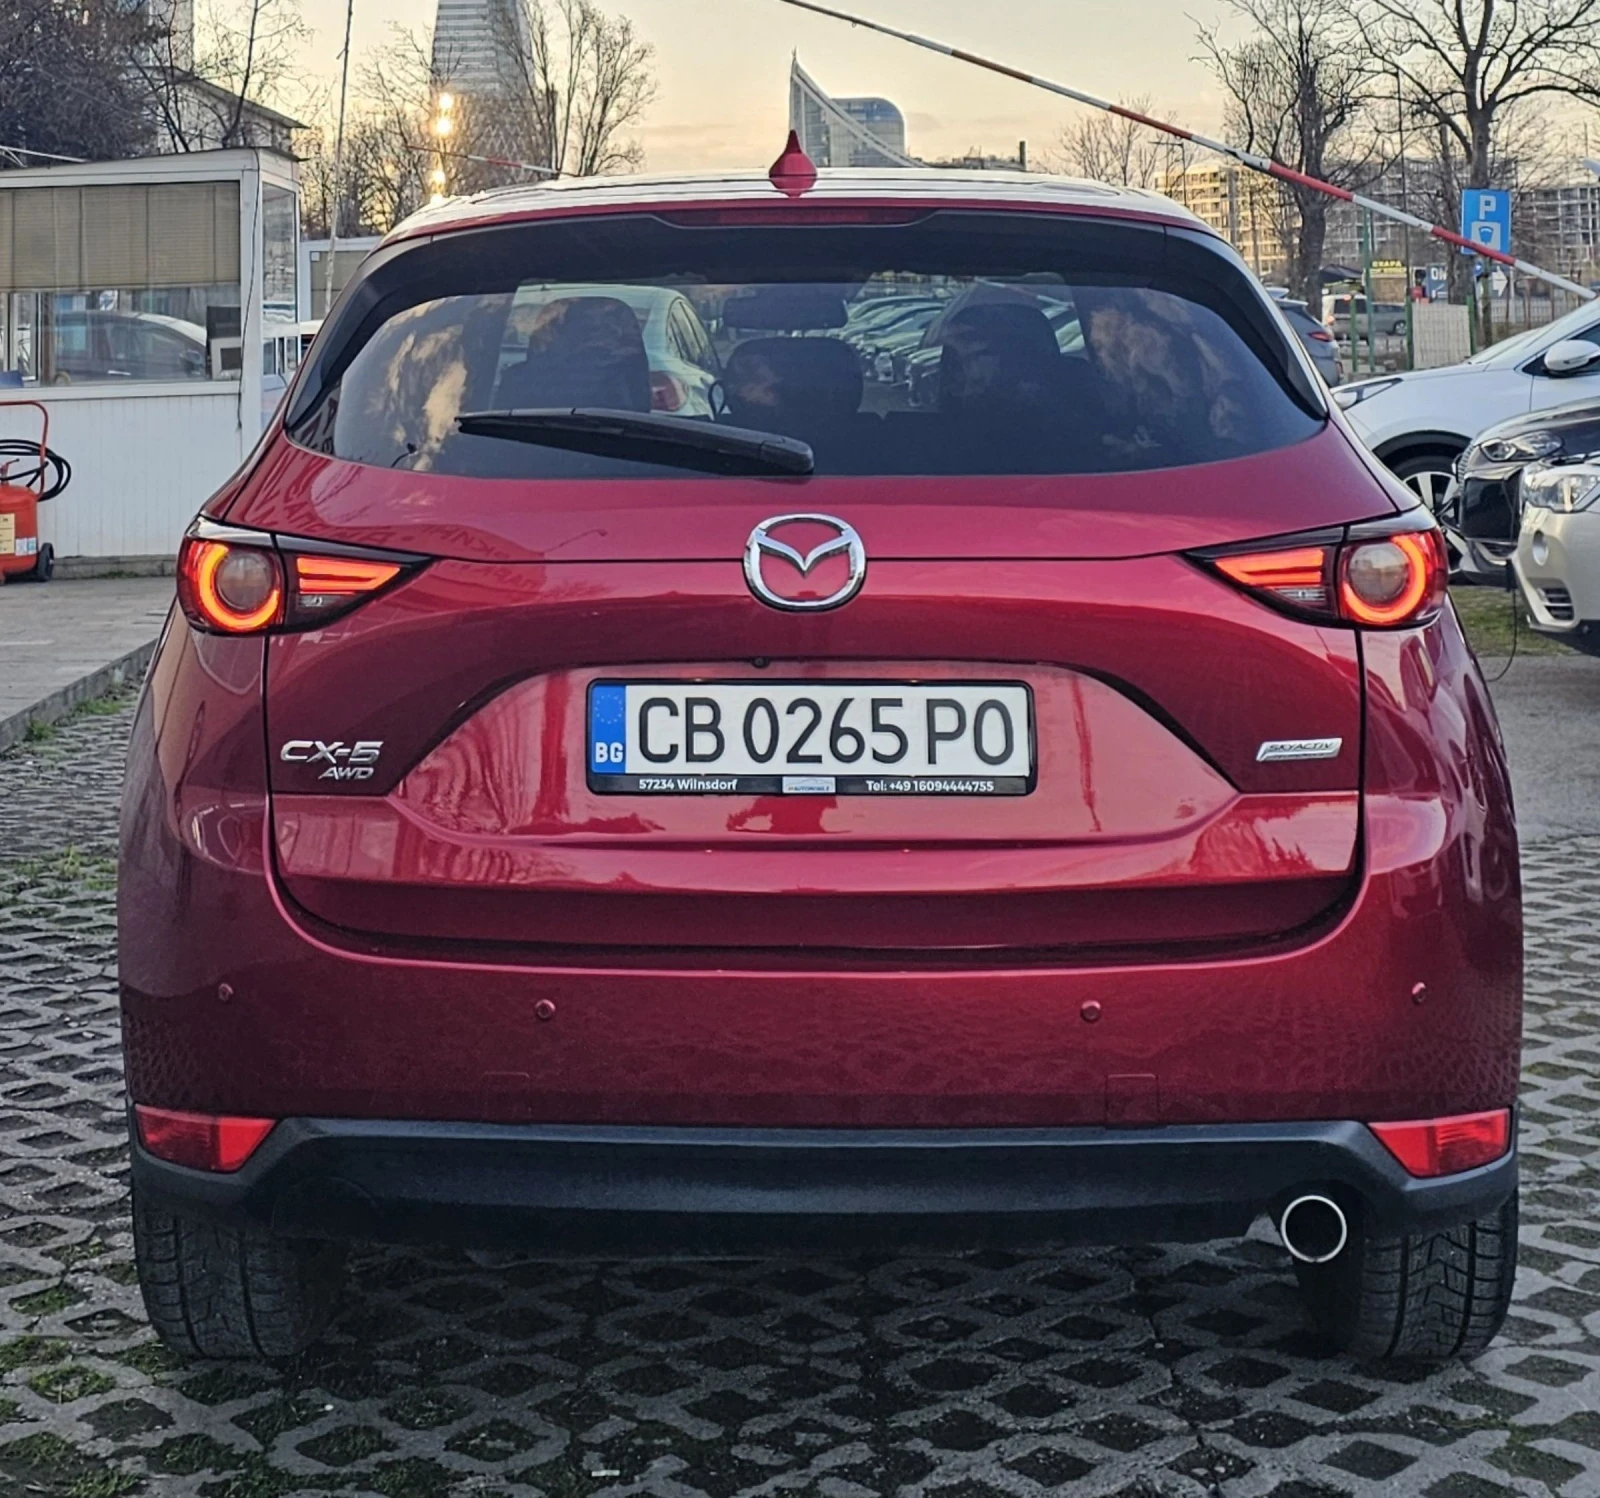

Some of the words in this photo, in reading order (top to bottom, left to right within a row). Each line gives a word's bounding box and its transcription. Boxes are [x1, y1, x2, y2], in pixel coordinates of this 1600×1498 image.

[1479, 194, 1497, 220] P
[639, 697, 725, 763] CB
[743, 697, 908, 764] 0265
[926, 698, 1014, 765] PO
[281, 740, 384, 764] CX-5
[595, 742, 624, 763] BG
[1269, 742, 1334, 752] SKYACTIV
[318, 766, 375, 780] AWD
[639, 778, 675, 790] 57234
[677, 777, 738, 790] Wilnsdorf
[866, 779, 887, 791] Tel:
[889, 780, 914, 792] +49
